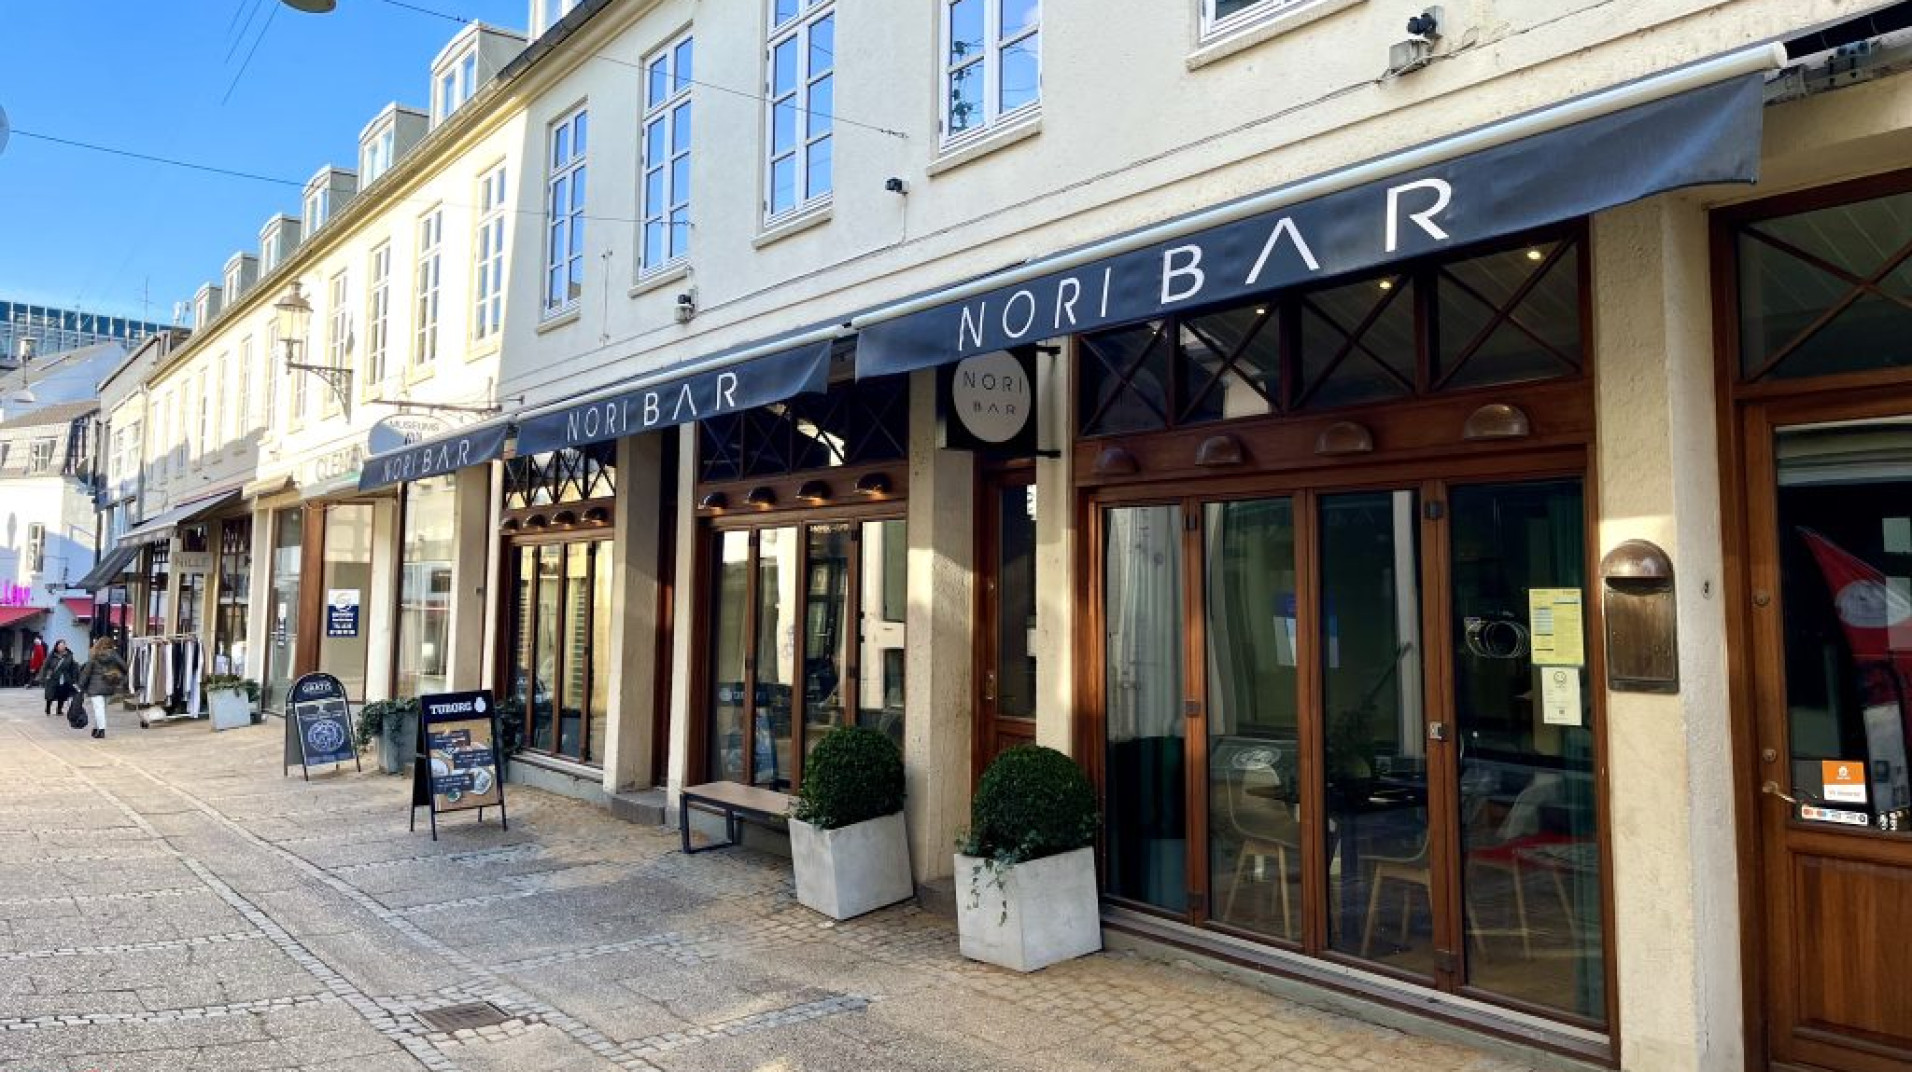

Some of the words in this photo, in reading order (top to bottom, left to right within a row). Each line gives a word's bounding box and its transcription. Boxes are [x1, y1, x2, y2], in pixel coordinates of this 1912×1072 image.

[958, 267, 1111, 352] NORI
[1160, 177, 1452, 305] BAR
[963, 370, 1022, 394] NORI
[566, 400, 628, 442] NORI
[643, 372, 738, 426] BAR
[974, 401, 1016, 415] BAR
[382, 454, 416, 482] NORI
[421, 439, 470, 475] BAR
[429, 702, 472, 715] TUBORG
